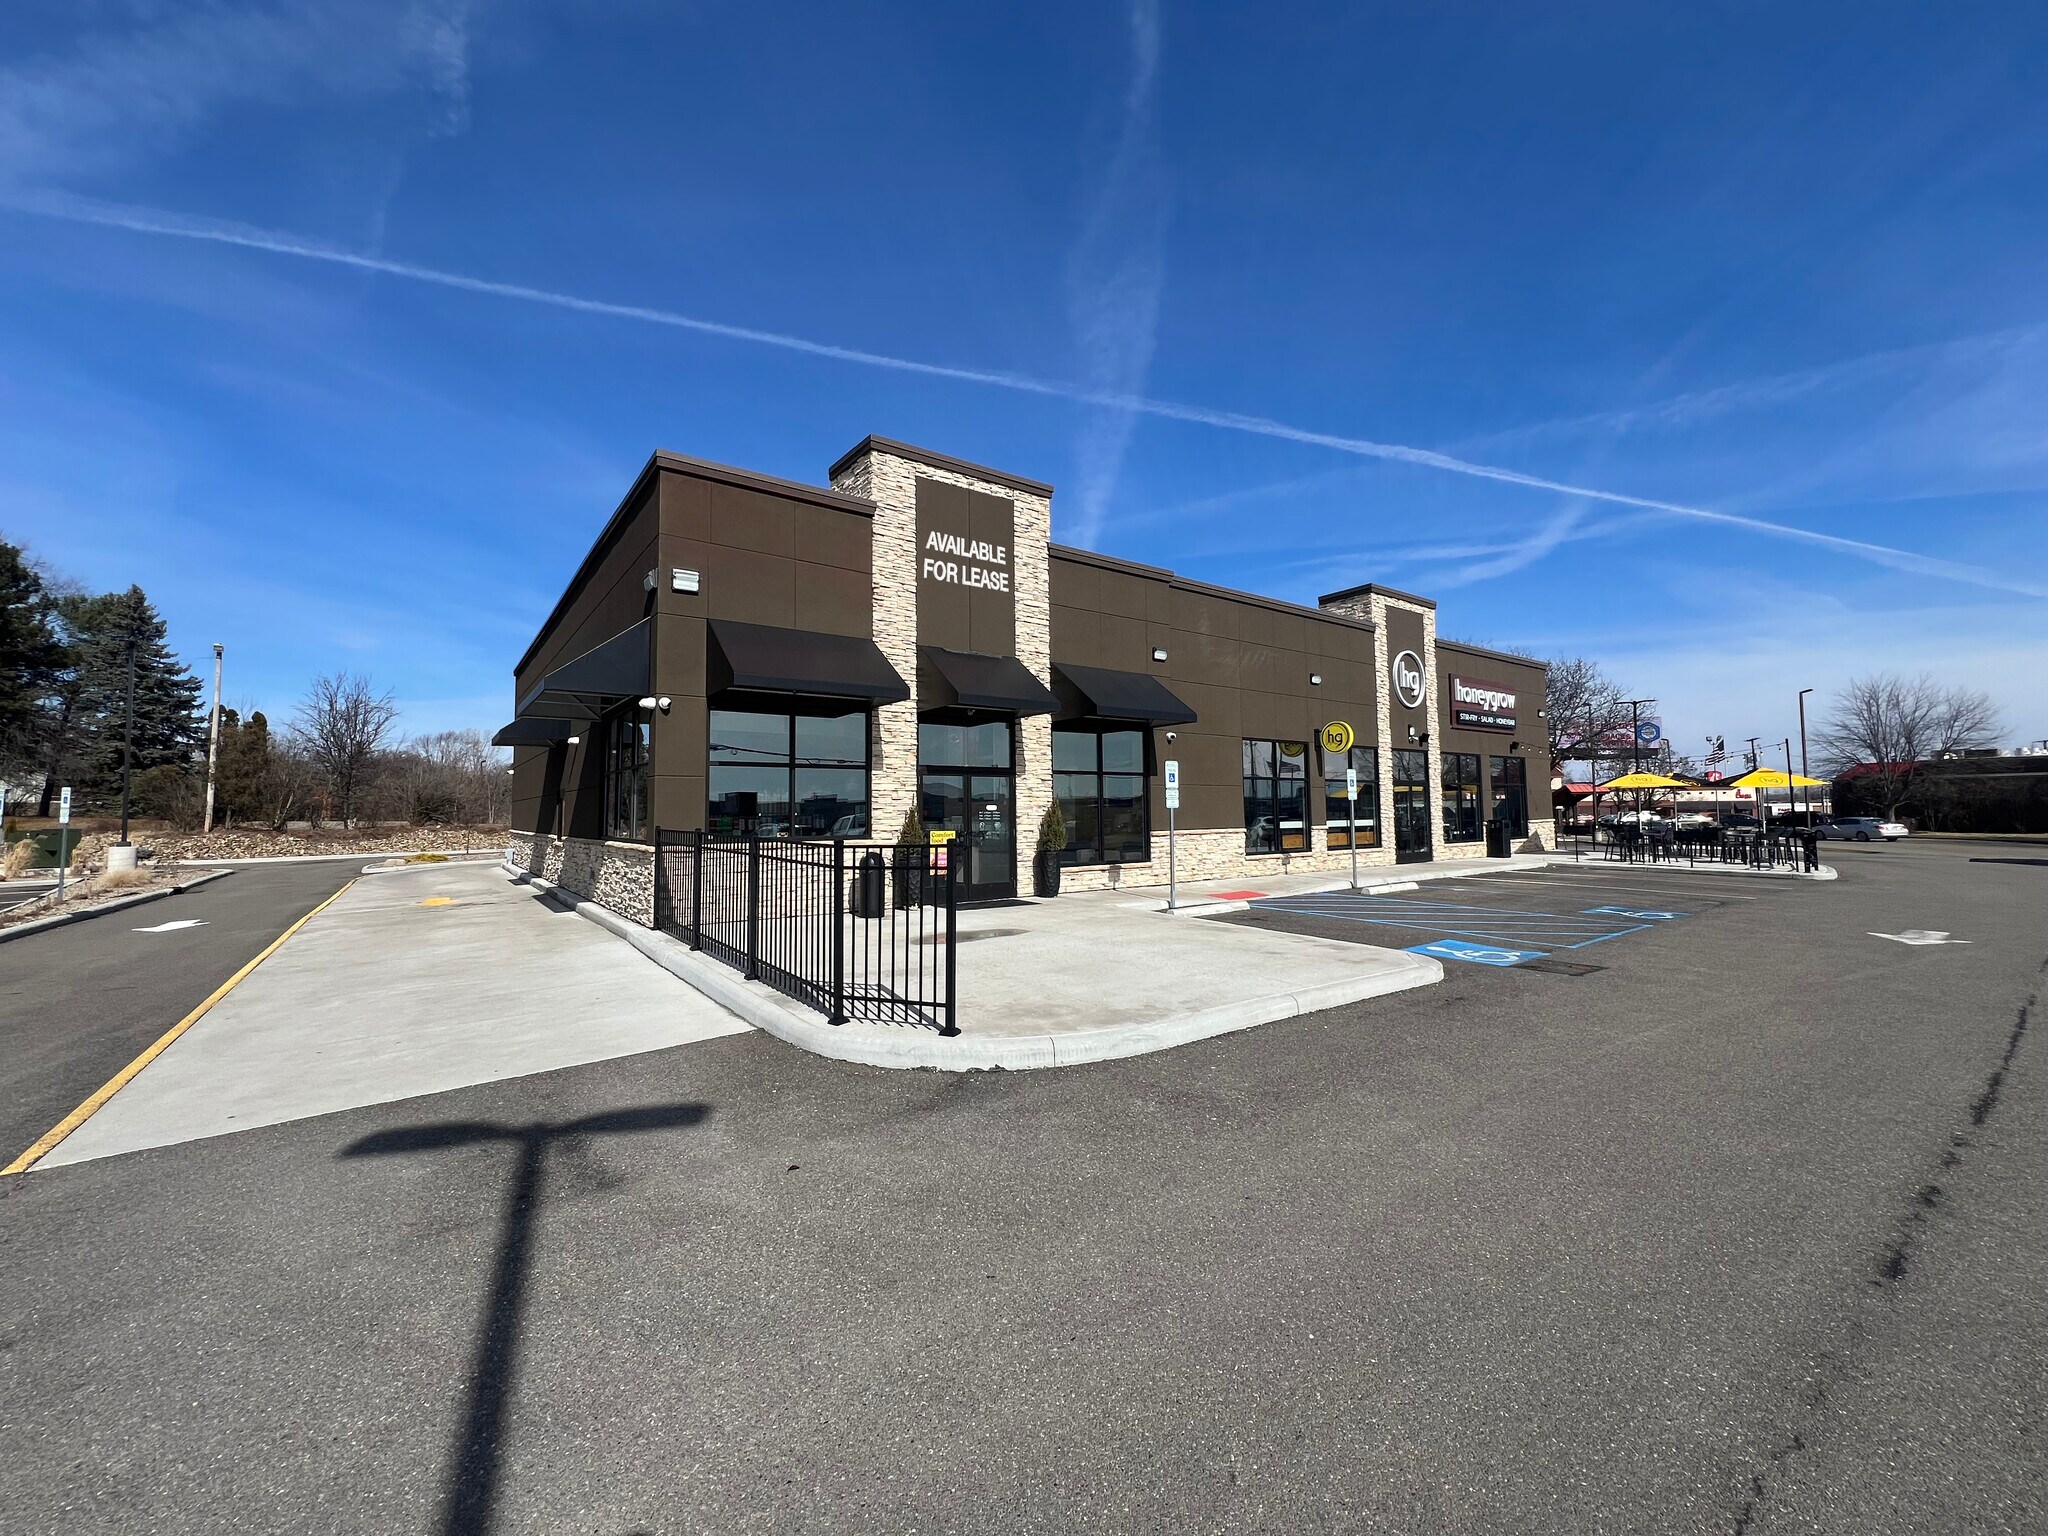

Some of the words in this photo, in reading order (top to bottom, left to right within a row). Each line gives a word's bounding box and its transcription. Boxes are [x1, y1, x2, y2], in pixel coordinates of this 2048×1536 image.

[926, 531, 1006, 565] AVAILABLE
[923, 558, 958, 584] FOR
[962, 565, 1009, 592] LEASE
[1400, 661, 1419, 695] hg
[1454, 678, 1516, 712] honeygrow
[1327, 730, 1343, 746] hg
